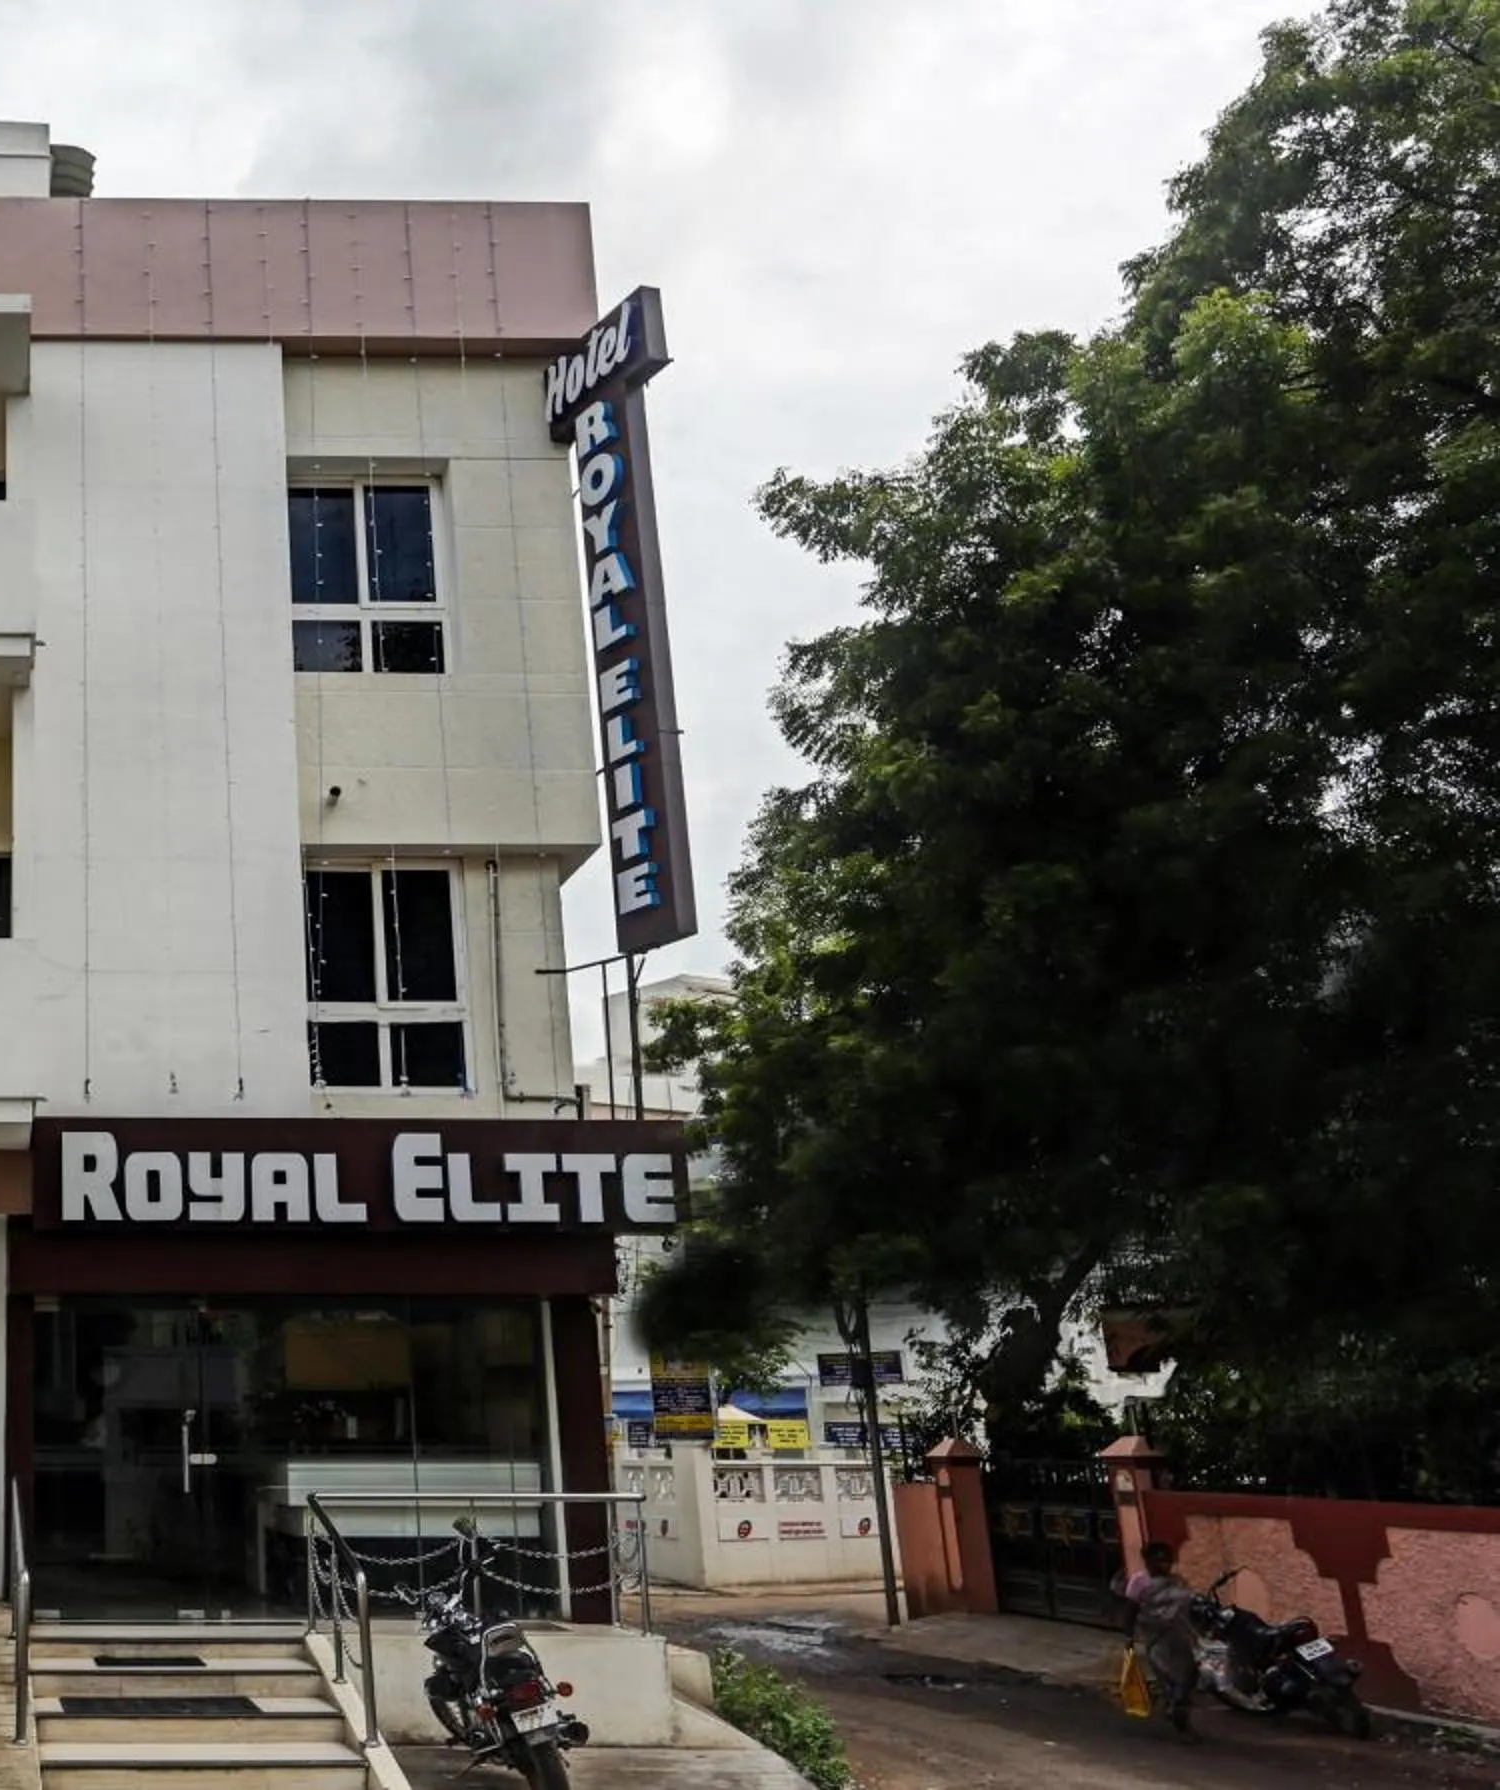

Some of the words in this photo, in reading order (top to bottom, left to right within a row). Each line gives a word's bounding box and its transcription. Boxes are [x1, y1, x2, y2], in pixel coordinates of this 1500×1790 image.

[546, 301, 631, 423] Hotel
[575, 400, 636, 652] ROYAL
[600, 657, 660, 915] ELITE
[61, 1130, 368, 1223] ROYAL
[392, 1132, 677, 1224] ELITE
